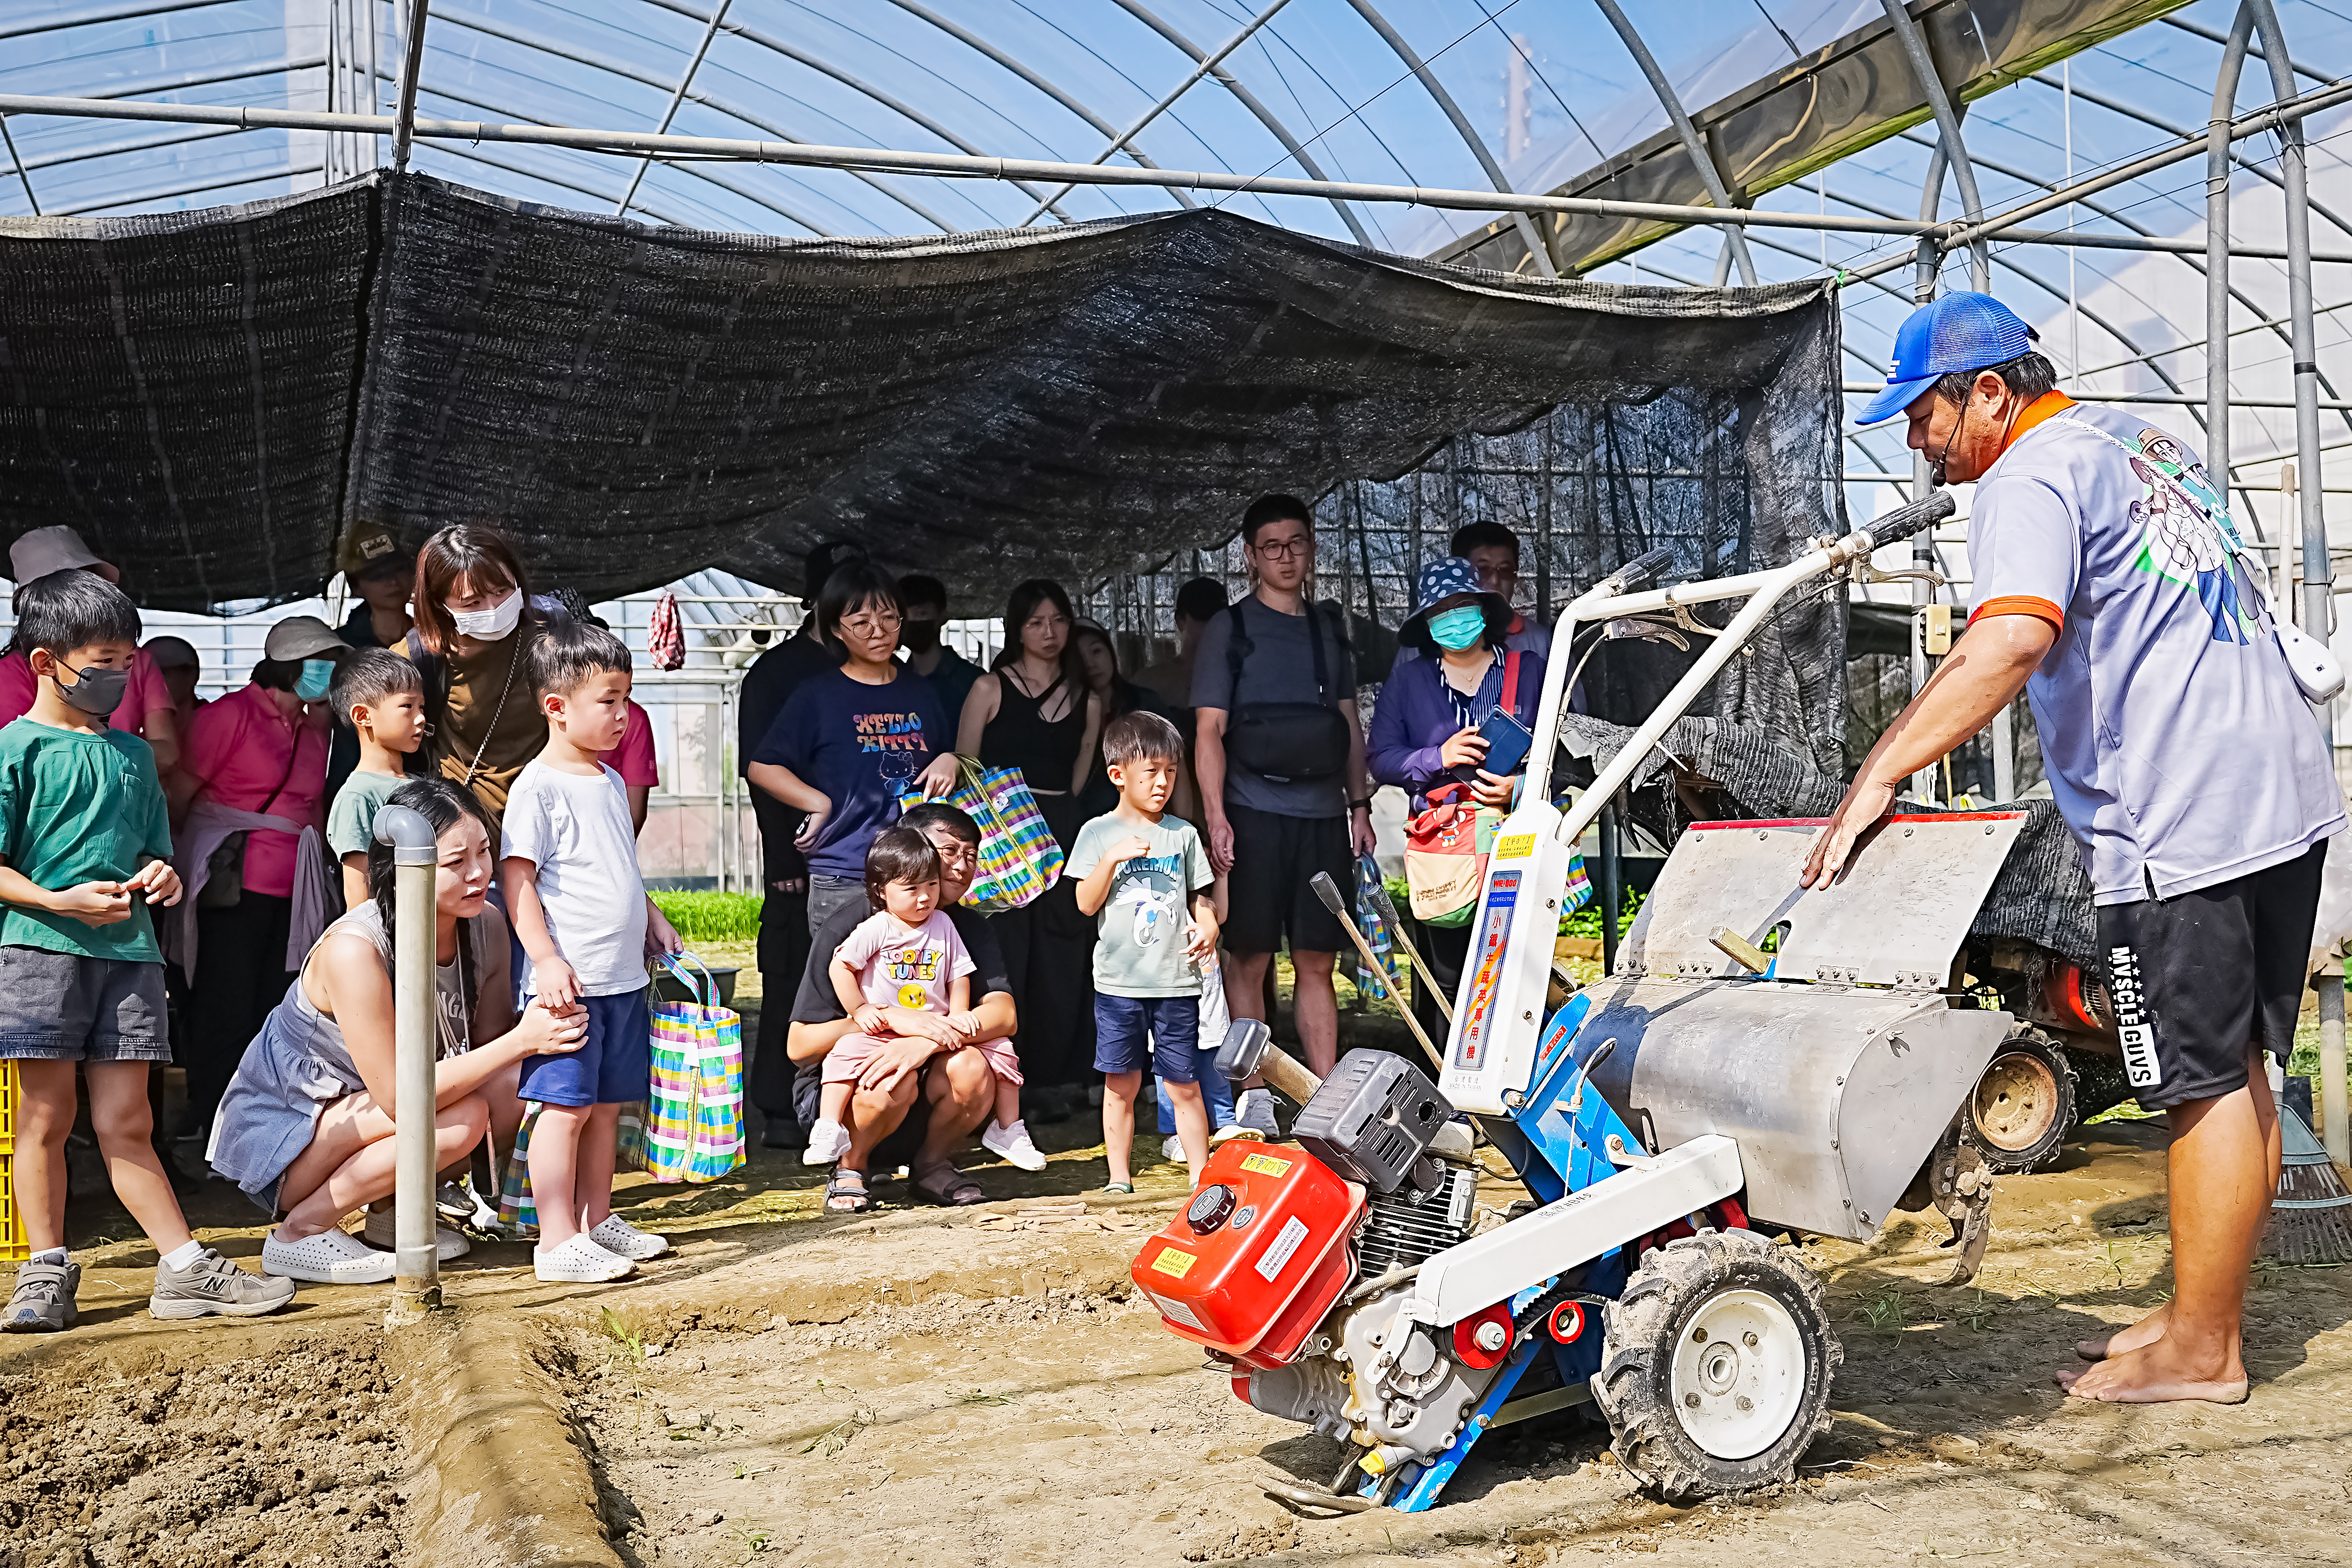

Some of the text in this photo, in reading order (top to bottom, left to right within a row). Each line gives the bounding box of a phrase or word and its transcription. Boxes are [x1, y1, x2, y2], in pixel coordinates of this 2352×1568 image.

[853, 712, 922, 734] HELLO
[857, 733, 929, 753] KITTY
[884, 949, 944, 965] LOONEY
[887, 964, 936, 980] TUNES
